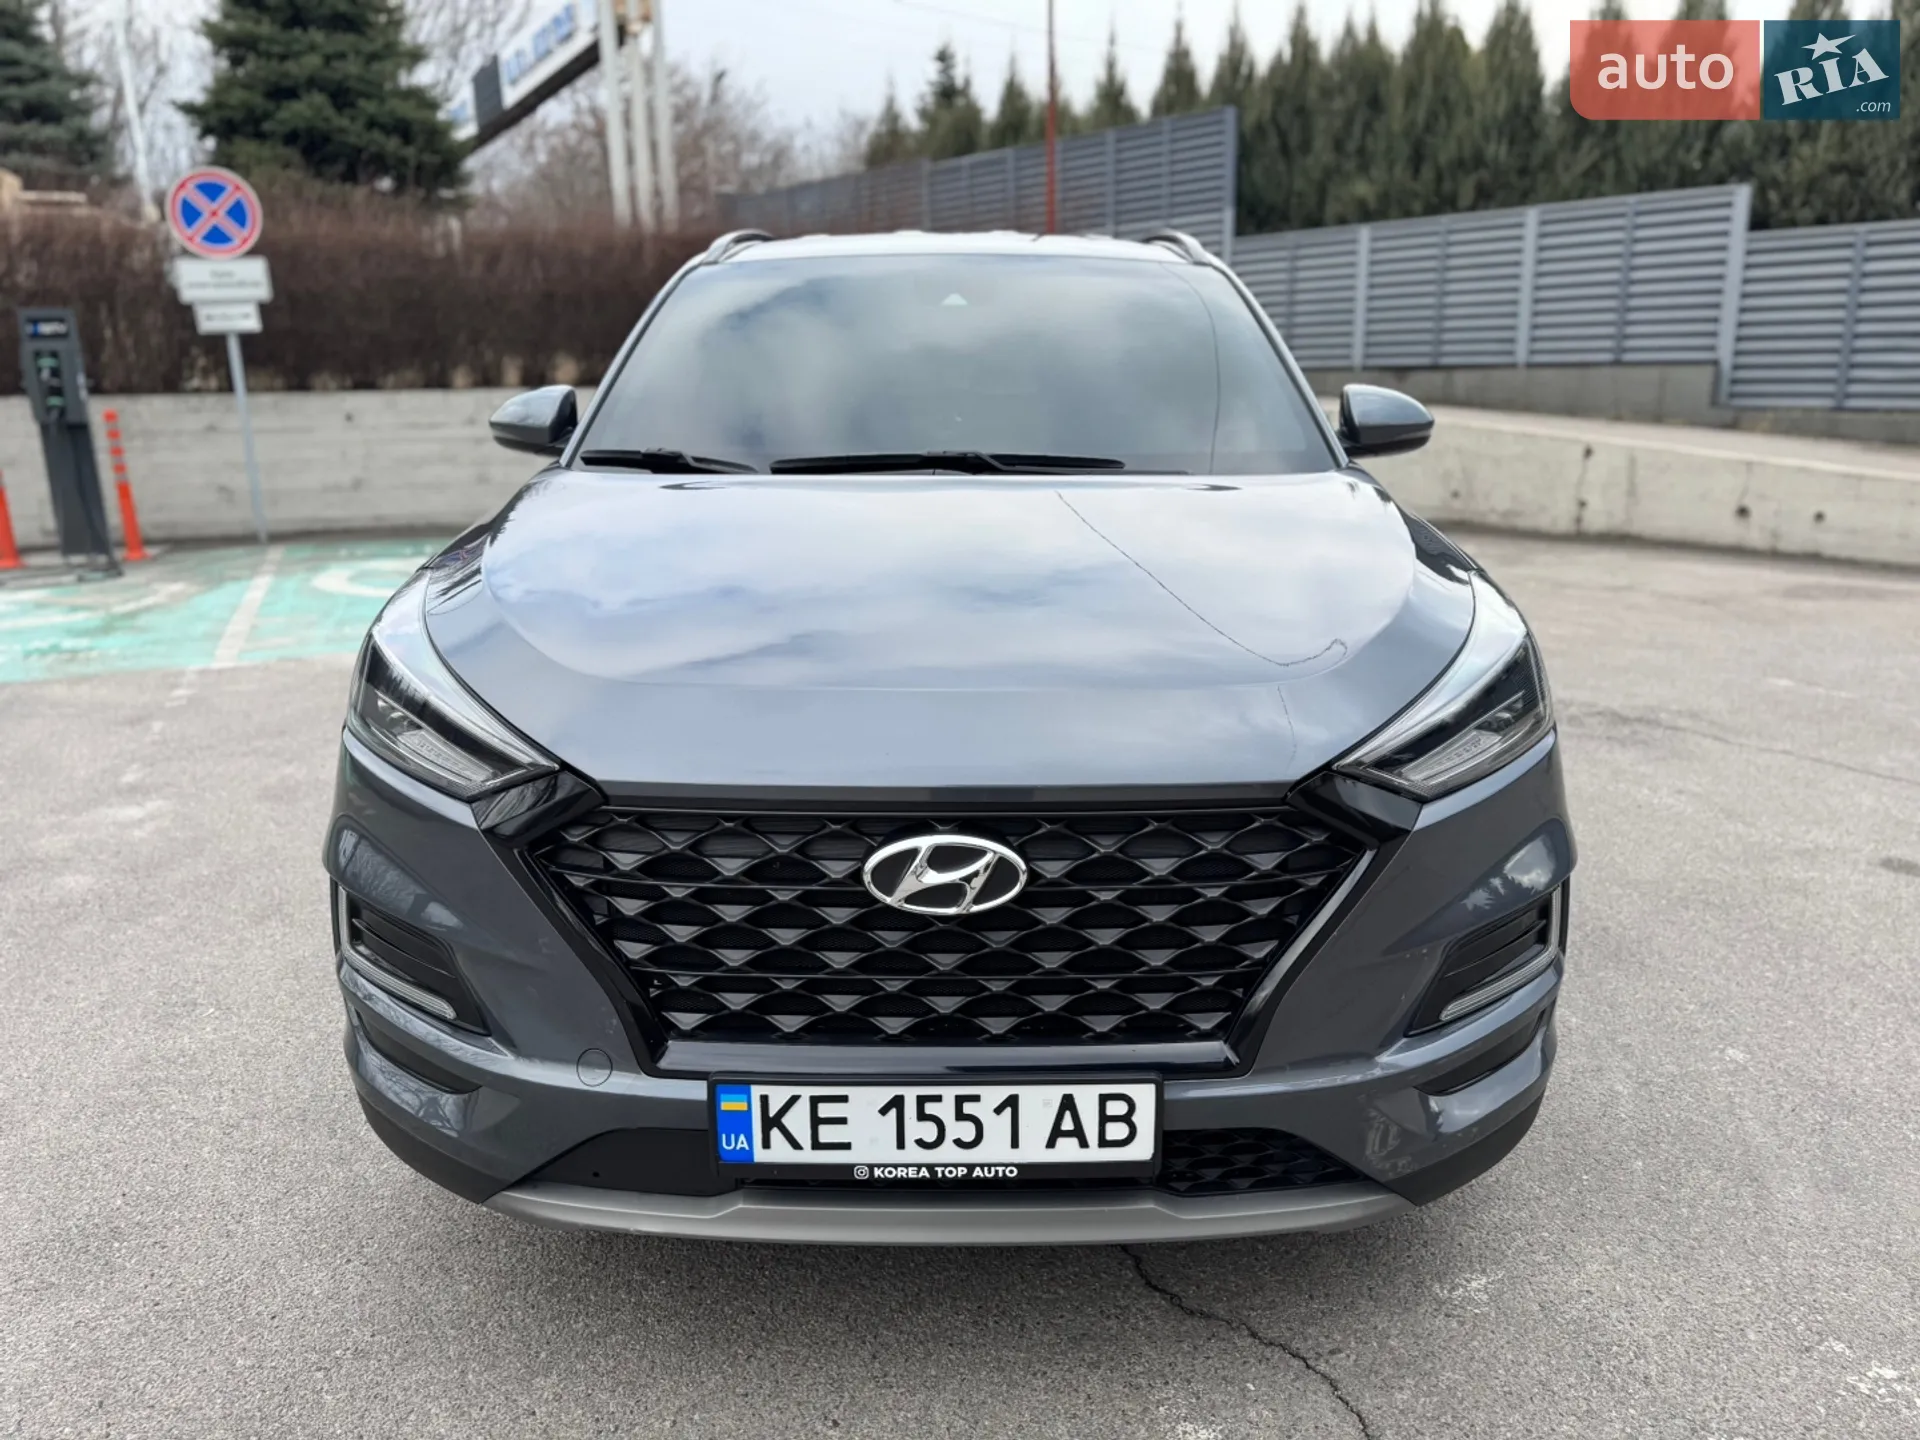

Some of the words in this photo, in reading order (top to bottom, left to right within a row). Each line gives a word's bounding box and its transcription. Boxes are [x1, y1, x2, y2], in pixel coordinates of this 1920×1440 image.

[760, 1093, 852, 1151] KE
[878, 1092, 1020, 1150] 1551
[1045, 1092, 1138, 1150] AB
[722, 1134, 749, 1151] UA
[873, 1166, 930, 1179] KOREA
[934, 1166, 967, 1179] TOP
[971, 1165, 1018, 1178] AUTO
